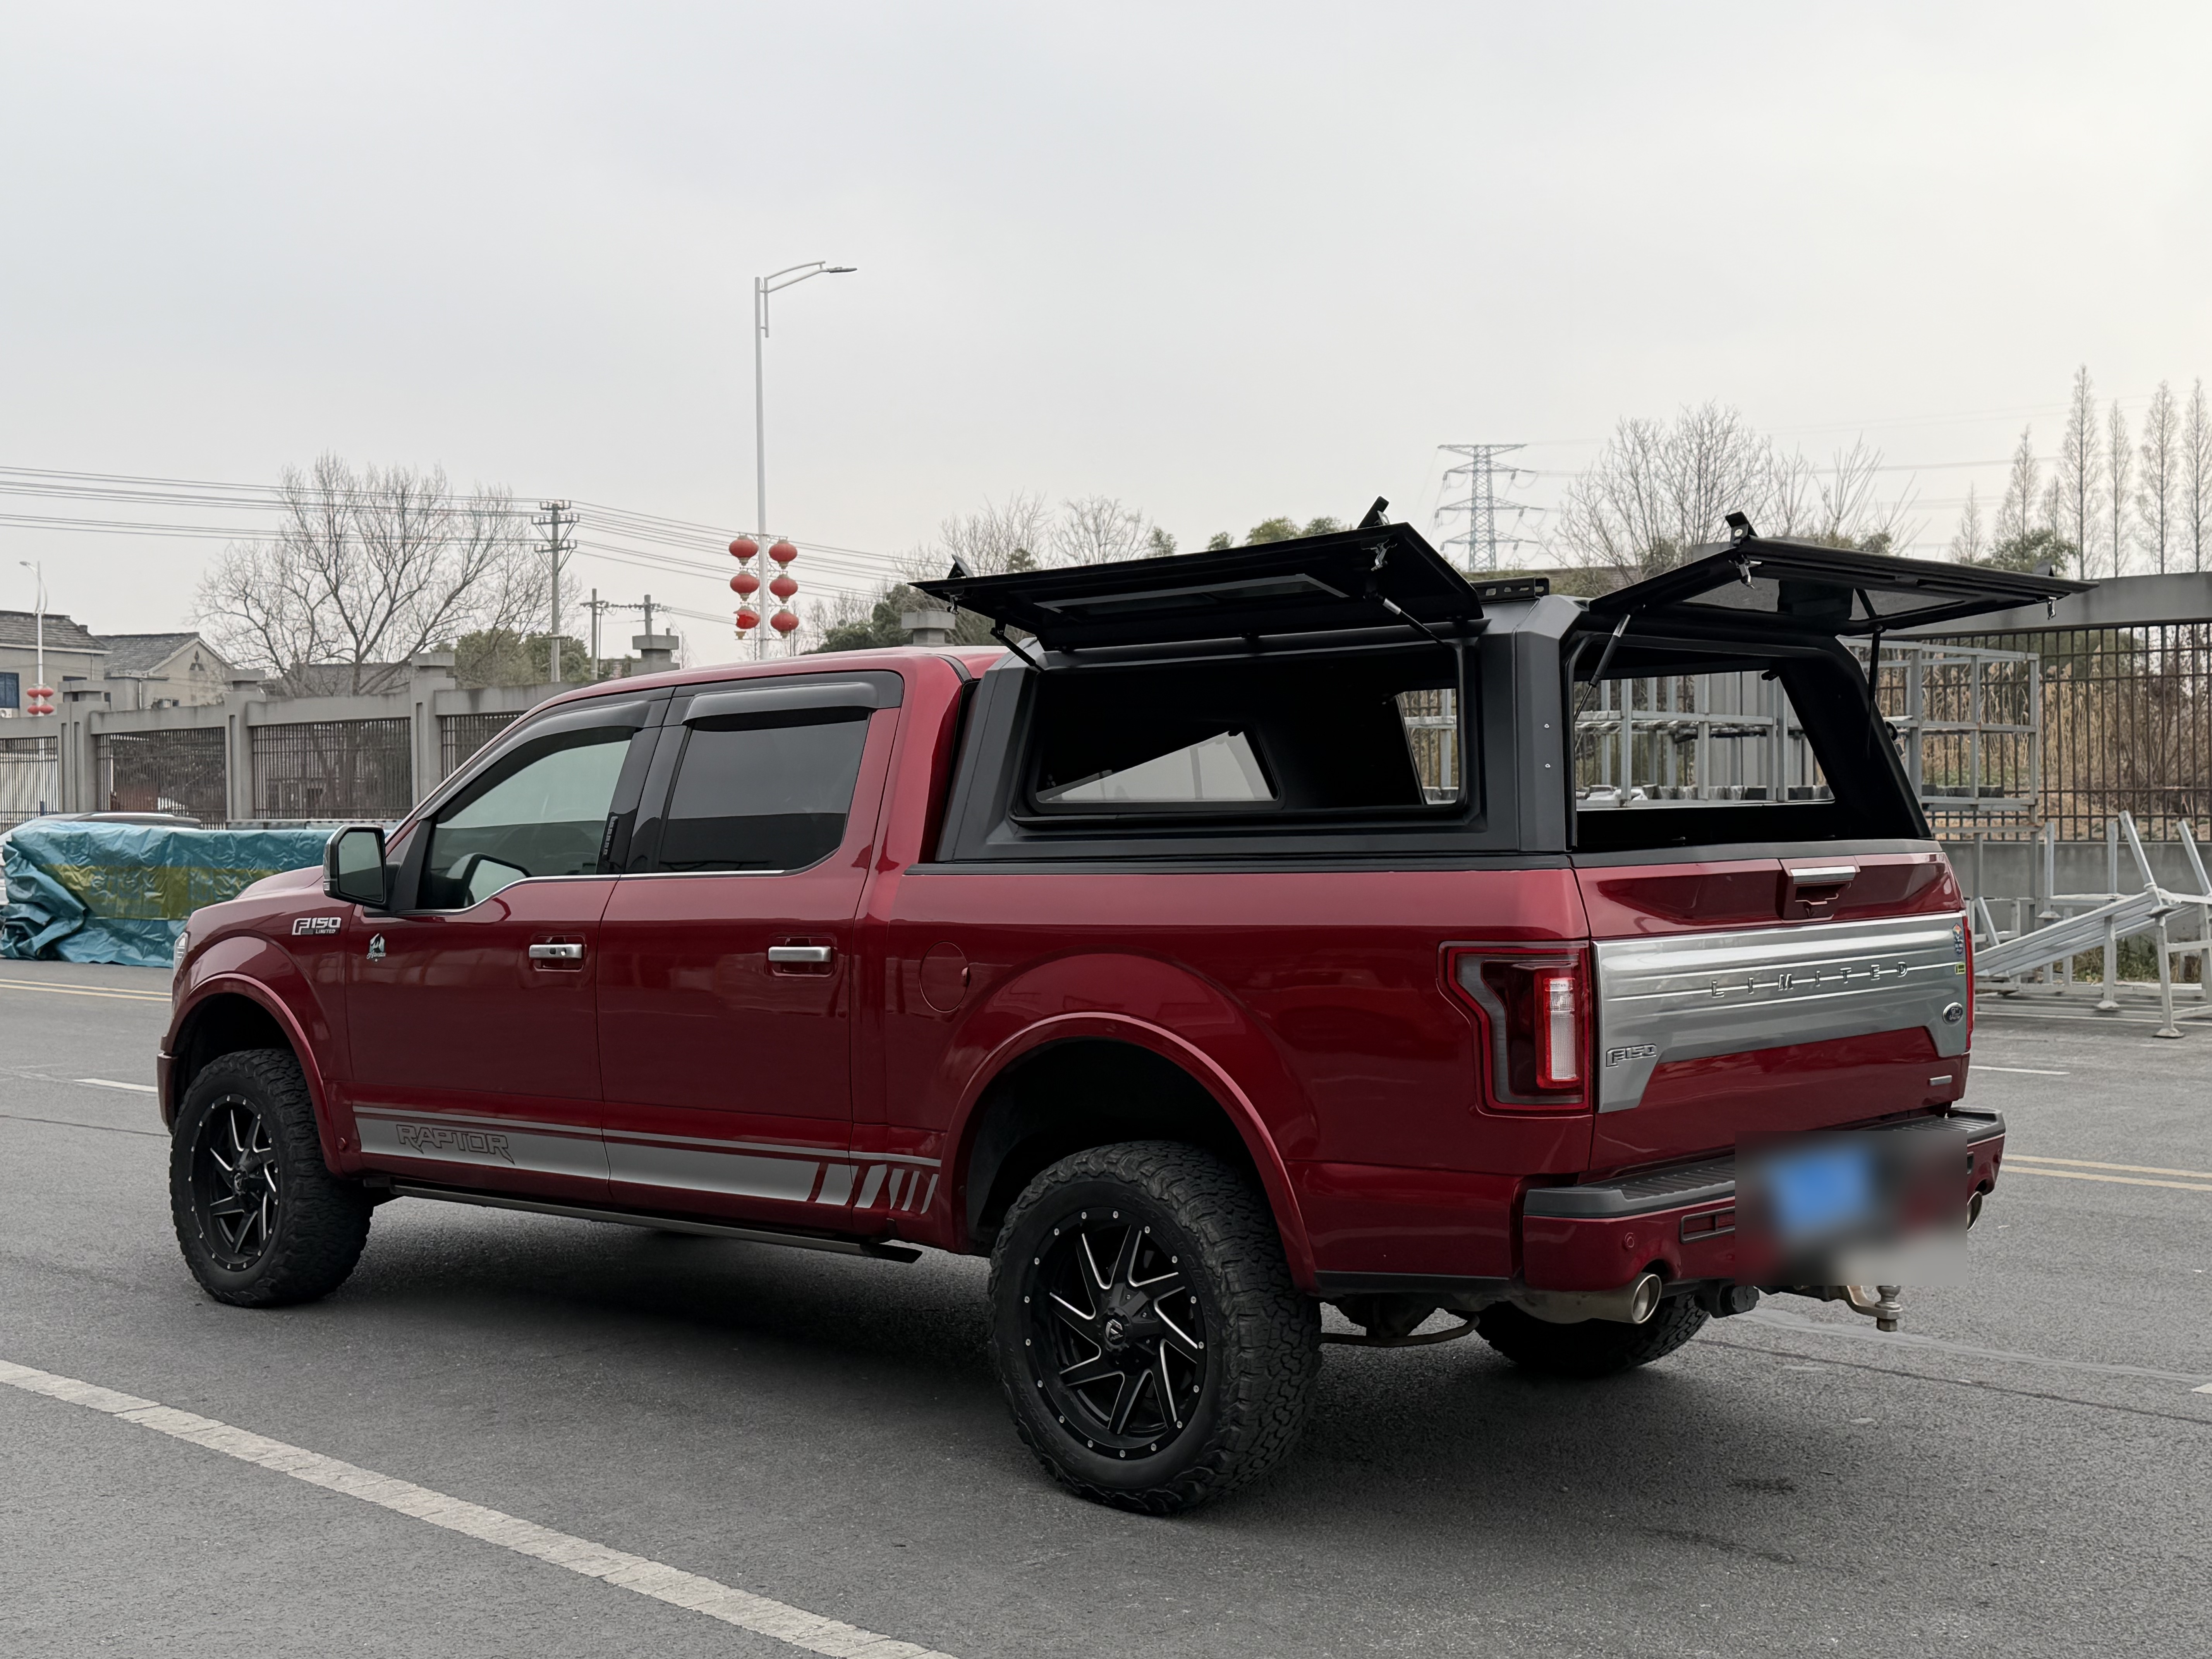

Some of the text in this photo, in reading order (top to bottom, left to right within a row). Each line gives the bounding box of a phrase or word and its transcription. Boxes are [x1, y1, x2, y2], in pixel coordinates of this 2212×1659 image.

[292, 917, 342, 935] F150
[1711, 961, 1908, 998] LIMITED
[1606, 1043, 1657, 1068] F150
[396, 1124, 515, 1166] RAPTOR
